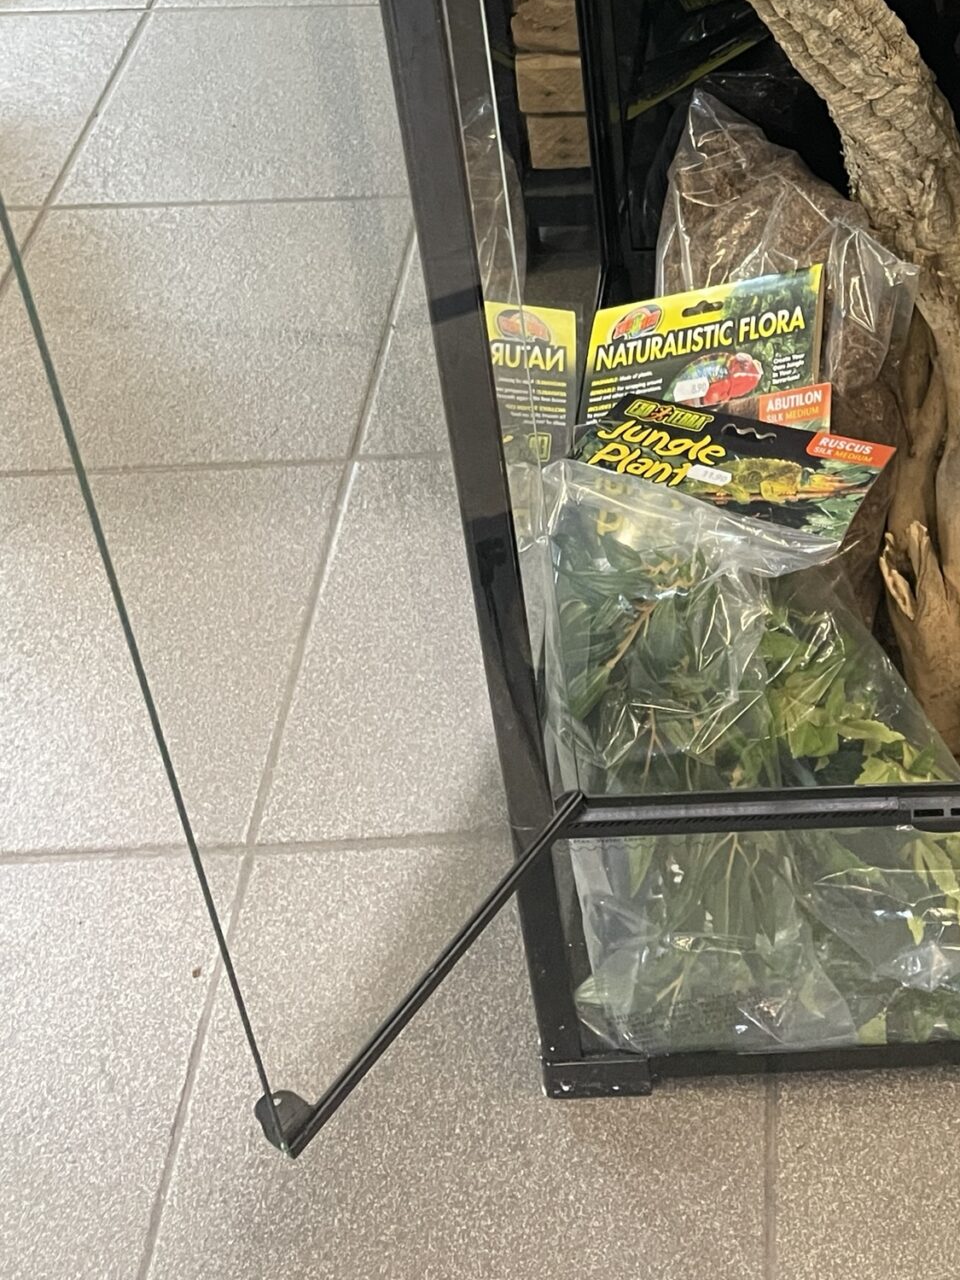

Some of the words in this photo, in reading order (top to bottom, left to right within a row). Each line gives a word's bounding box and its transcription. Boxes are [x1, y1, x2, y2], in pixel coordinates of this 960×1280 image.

[595, 320, 734, 371] NATURALISTIC
[738, 305, 806, 344] FLORA
[766, 389, 823, 413] ABUTILON
[784, 406, 820, 420] MEDIUM
[628, 400, 658, 418] EXO
[665, 409, 708, 429] TERRA
[596, 419, 727, 466] Jungle
[812, 445, 834, 456] SILK
[833, 450, 873, 464] MEDIUM
[818, 436, 874, 455] RUSCUS
[587, 441, 693, 487] Plant
